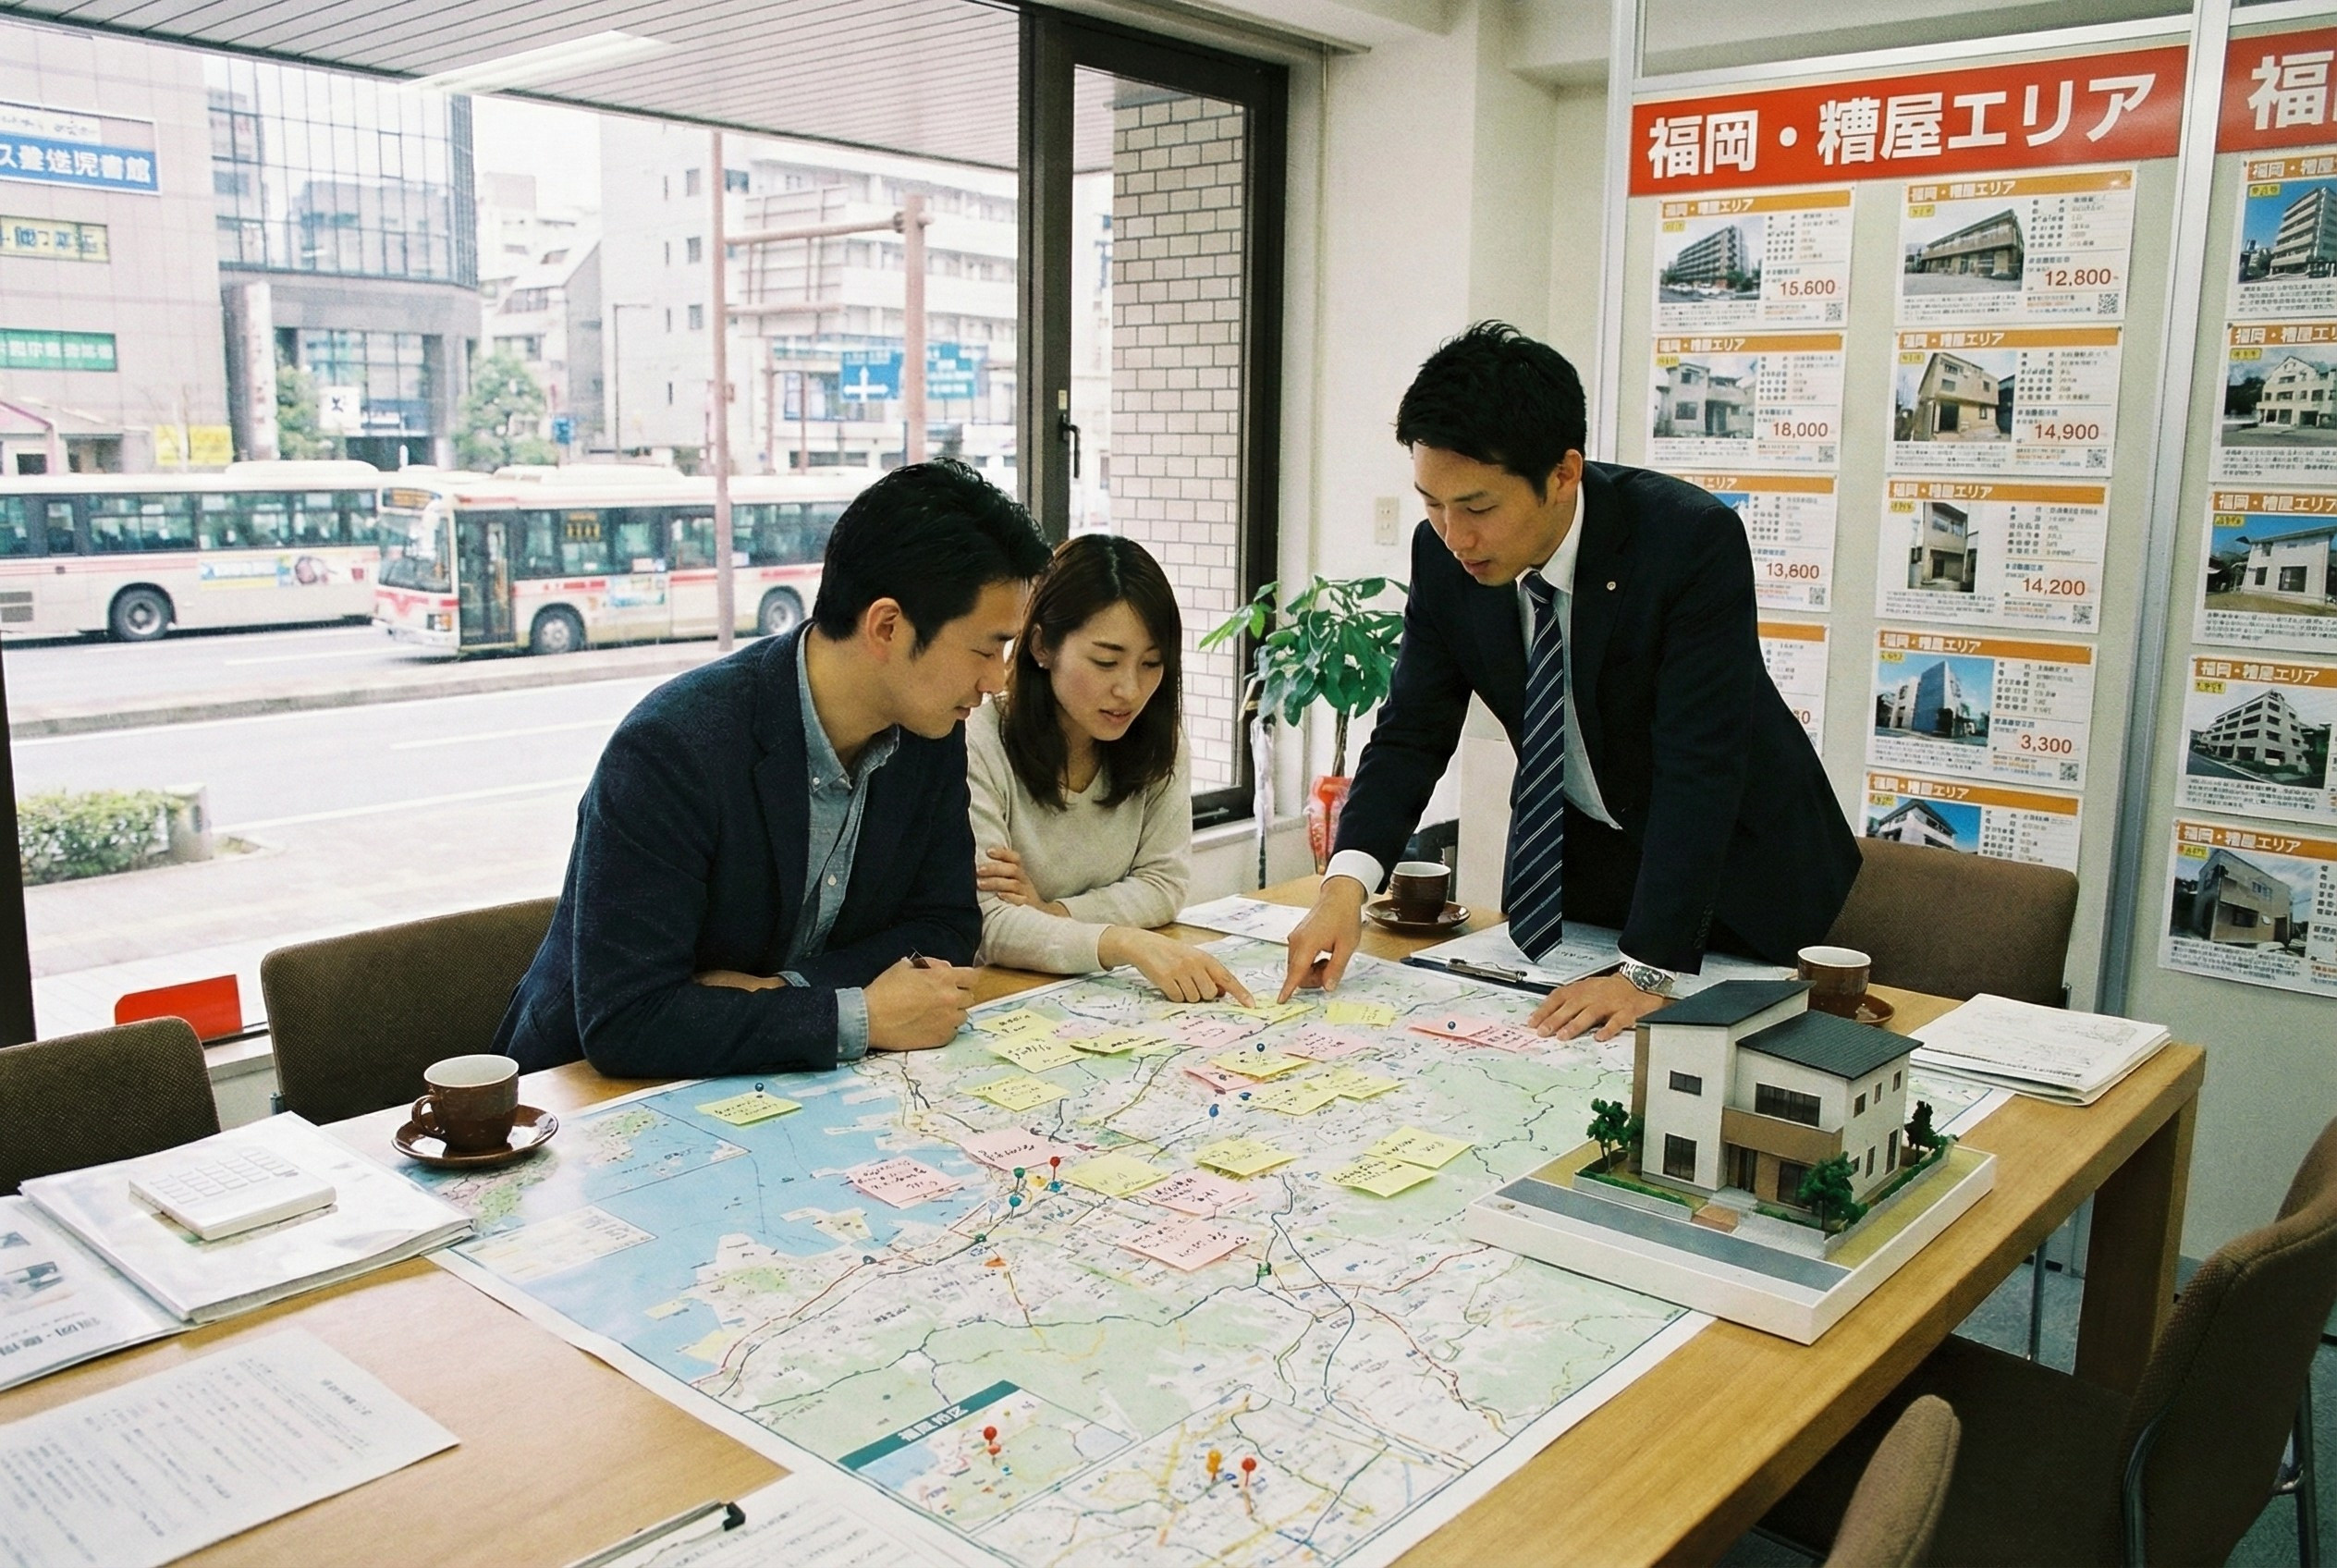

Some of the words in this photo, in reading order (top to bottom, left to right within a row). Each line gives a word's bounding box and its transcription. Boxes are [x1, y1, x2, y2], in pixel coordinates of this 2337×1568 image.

[2247, 50, 2337, 130] 福
[1647, 72, 2158, 179] 福岡・糟屋エリア
[1773, 423, 1828, 438] 18,000
[2035, 423, 2099, 441] 14,900
[2023, 578, 2086, 596] 14,200
[2021, 734, 2073, 755] 3,300
